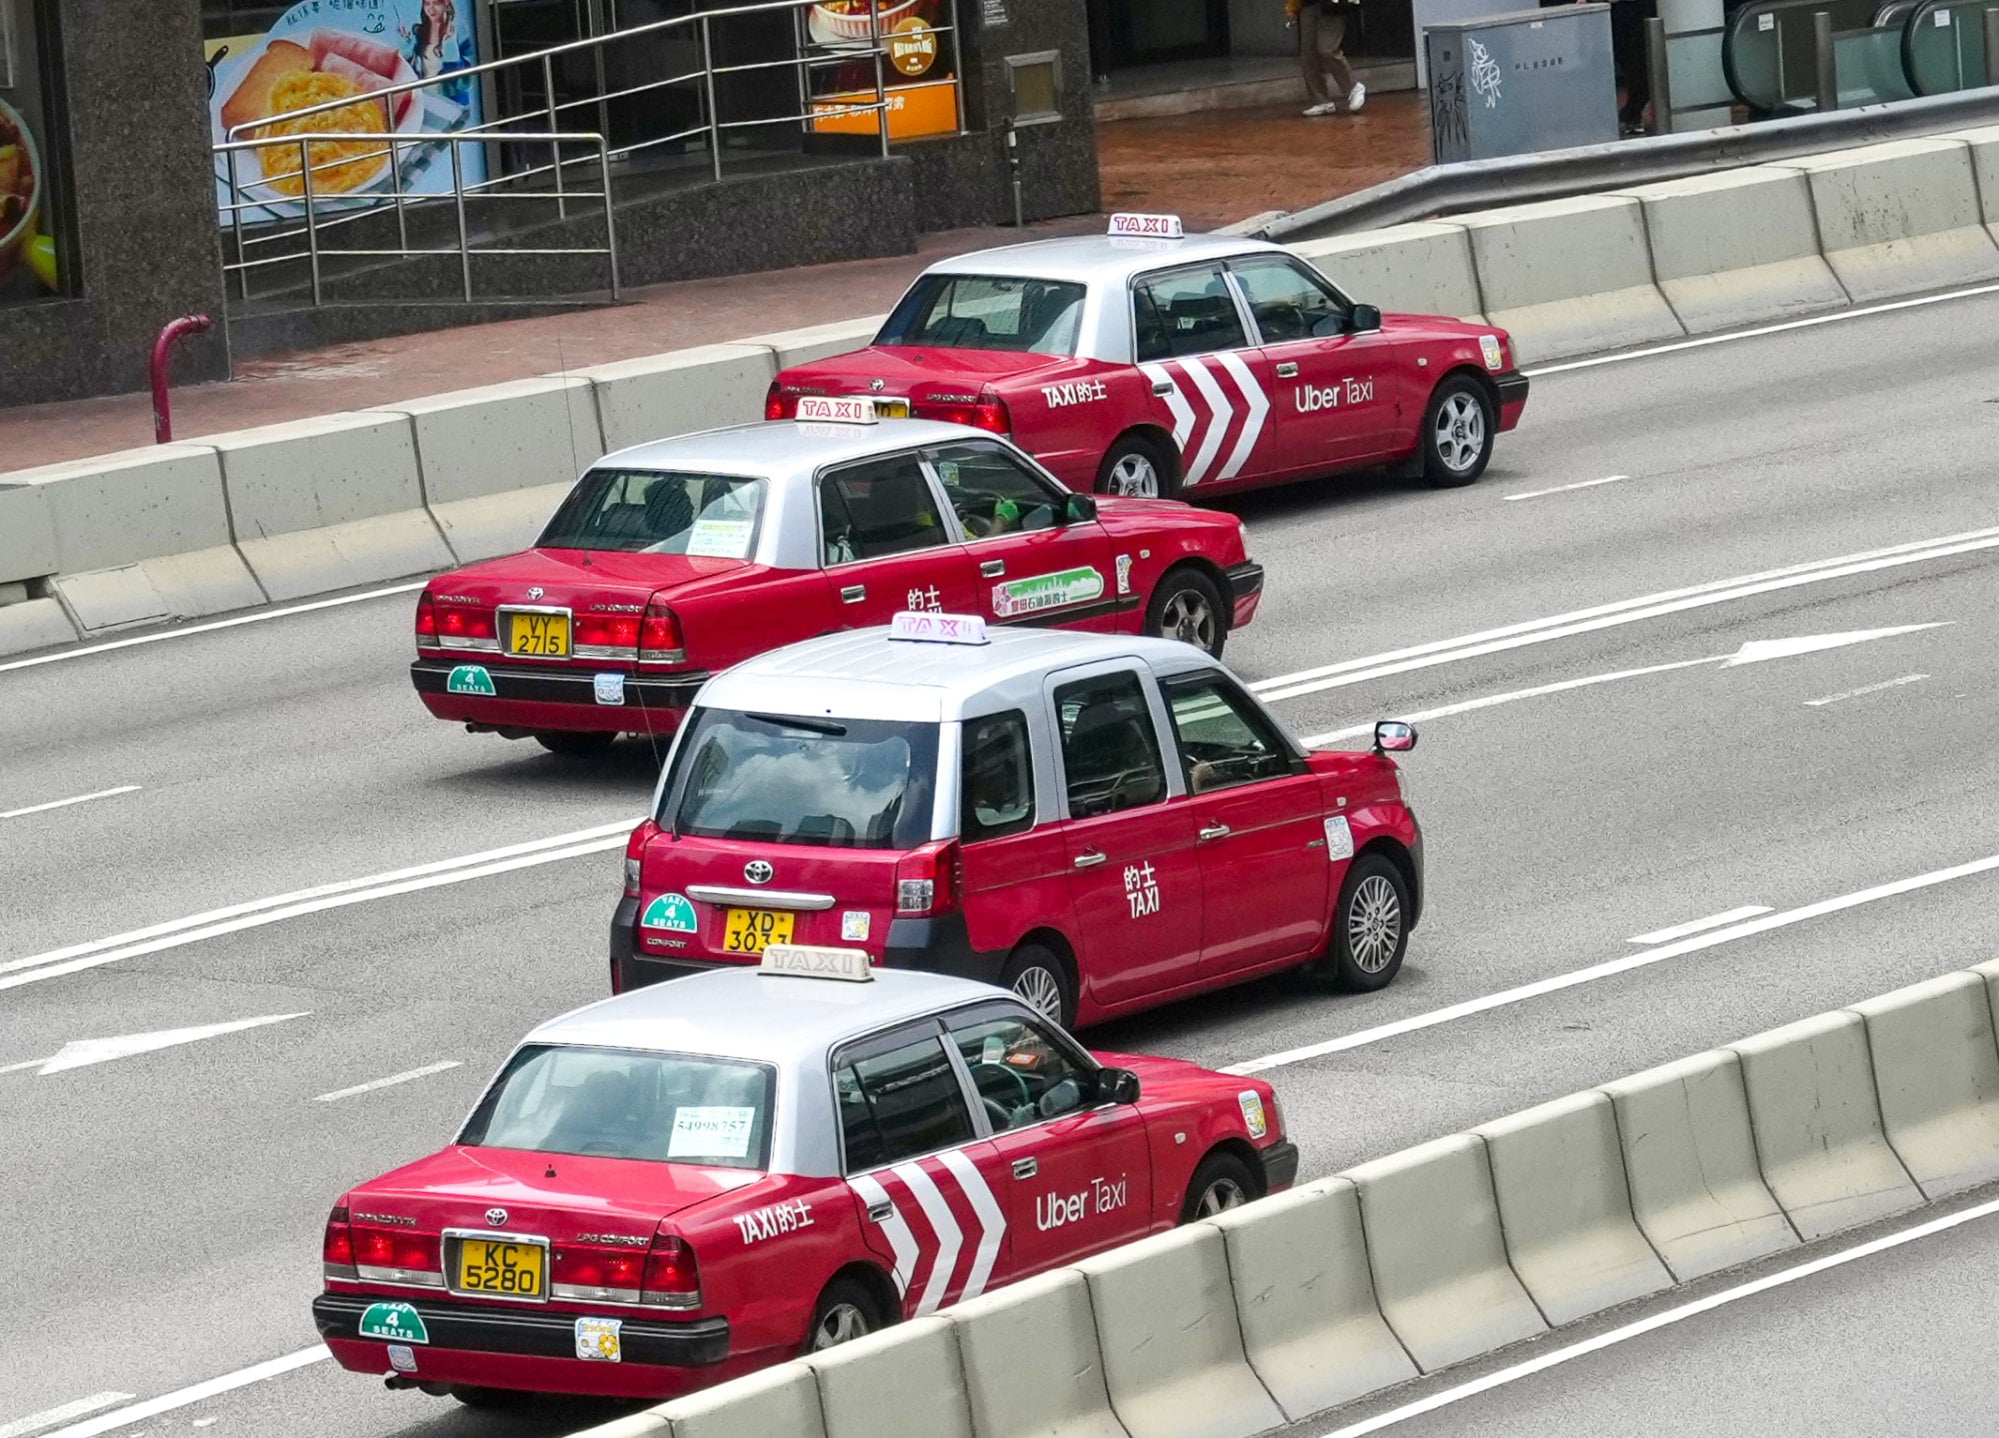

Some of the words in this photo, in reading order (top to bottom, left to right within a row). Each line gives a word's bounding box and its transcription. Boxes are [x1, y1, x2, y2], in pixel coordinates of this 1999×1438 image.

[1114, 216, 1169, 234] TAXI
[1295, 384, 1340, 413] Uber
[1342, 375, 1373, 404] Taxi
[803, 400, 862, 419] TAXI
[907, 584, 941, 612] 的士
[529, 616, 552, 635] VY
[898, 616, 971, 638] TAXI
[518, 635, 560, 654] 2715
[465, 671, 476, 685] 4
[1123, 860, 1157, 891] 的士
[664, 904, 676, 919] 4
[1127, 886, 1160, 919] TAXI
[652, 918, 687, 929] SEATS
[746, 912, 775, 932] XD
[769, 948, 854, 974] TAXI
[1036, 1191, 1089, 1232] Uber
[1090, 1172, 1127, 1215] Taxi
[485, 1243, 518, 1269] KC
[466, 1265, 535, 1293] 5280
[385, 1311, 399, 1327] 4
[373, 1325, 414, 1339] SEATS
